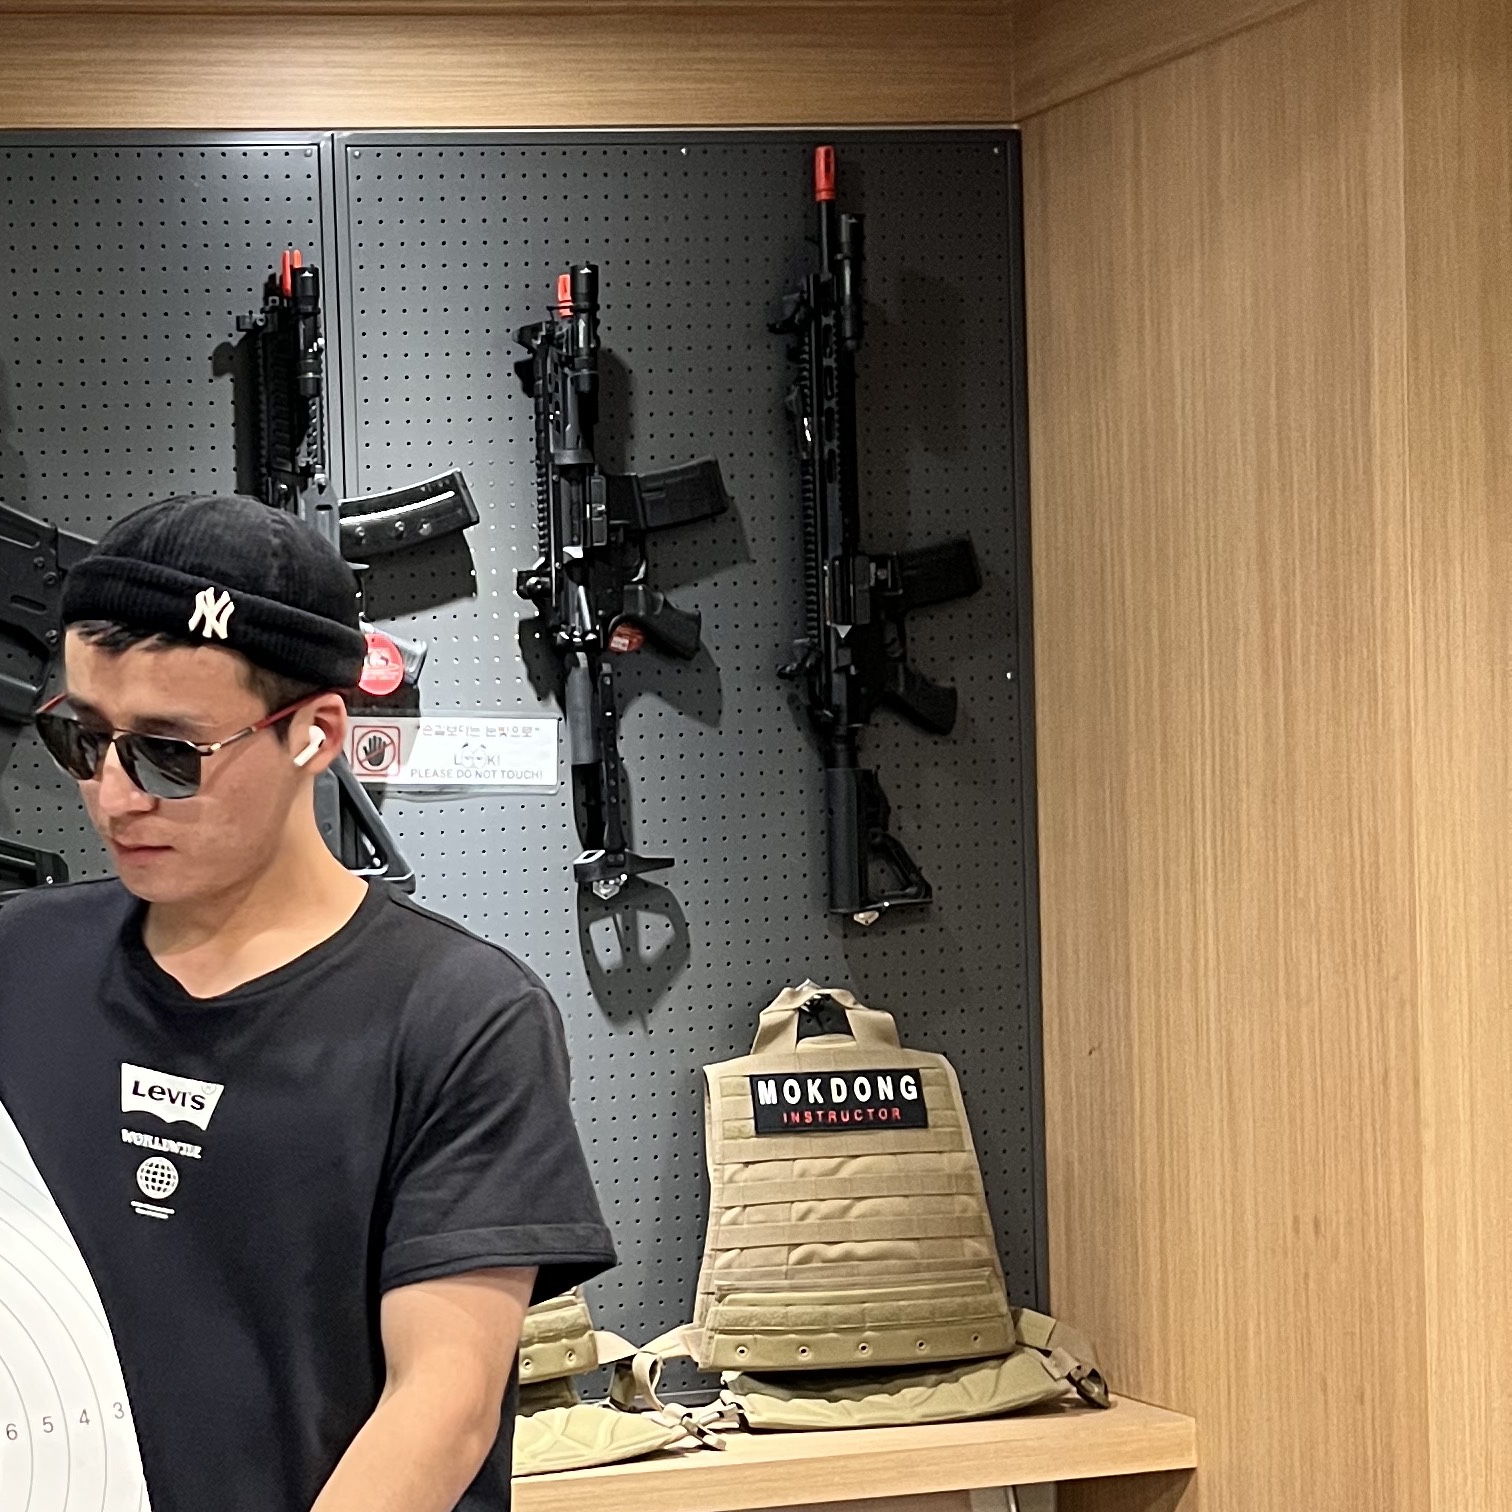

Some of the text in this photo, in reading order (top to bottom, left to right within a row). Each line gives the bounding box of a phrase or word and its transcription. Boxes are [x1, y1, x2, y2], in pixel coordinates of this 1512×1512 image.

[188, 587, 235, 639] NY
[410, 769, 543, 780] PLEASE DO NOT TOUCH!
[757, 1074, 919, 1106] MOKDONG
[782, 1107, 902, 1124] INSTRUCTOR
[6, 1424, 18, 1440] 6
[43, 1416, 54, 1433] 5
[79, 1409, 90, 1425] 4
[113, 1402, 124, 1419] 3
